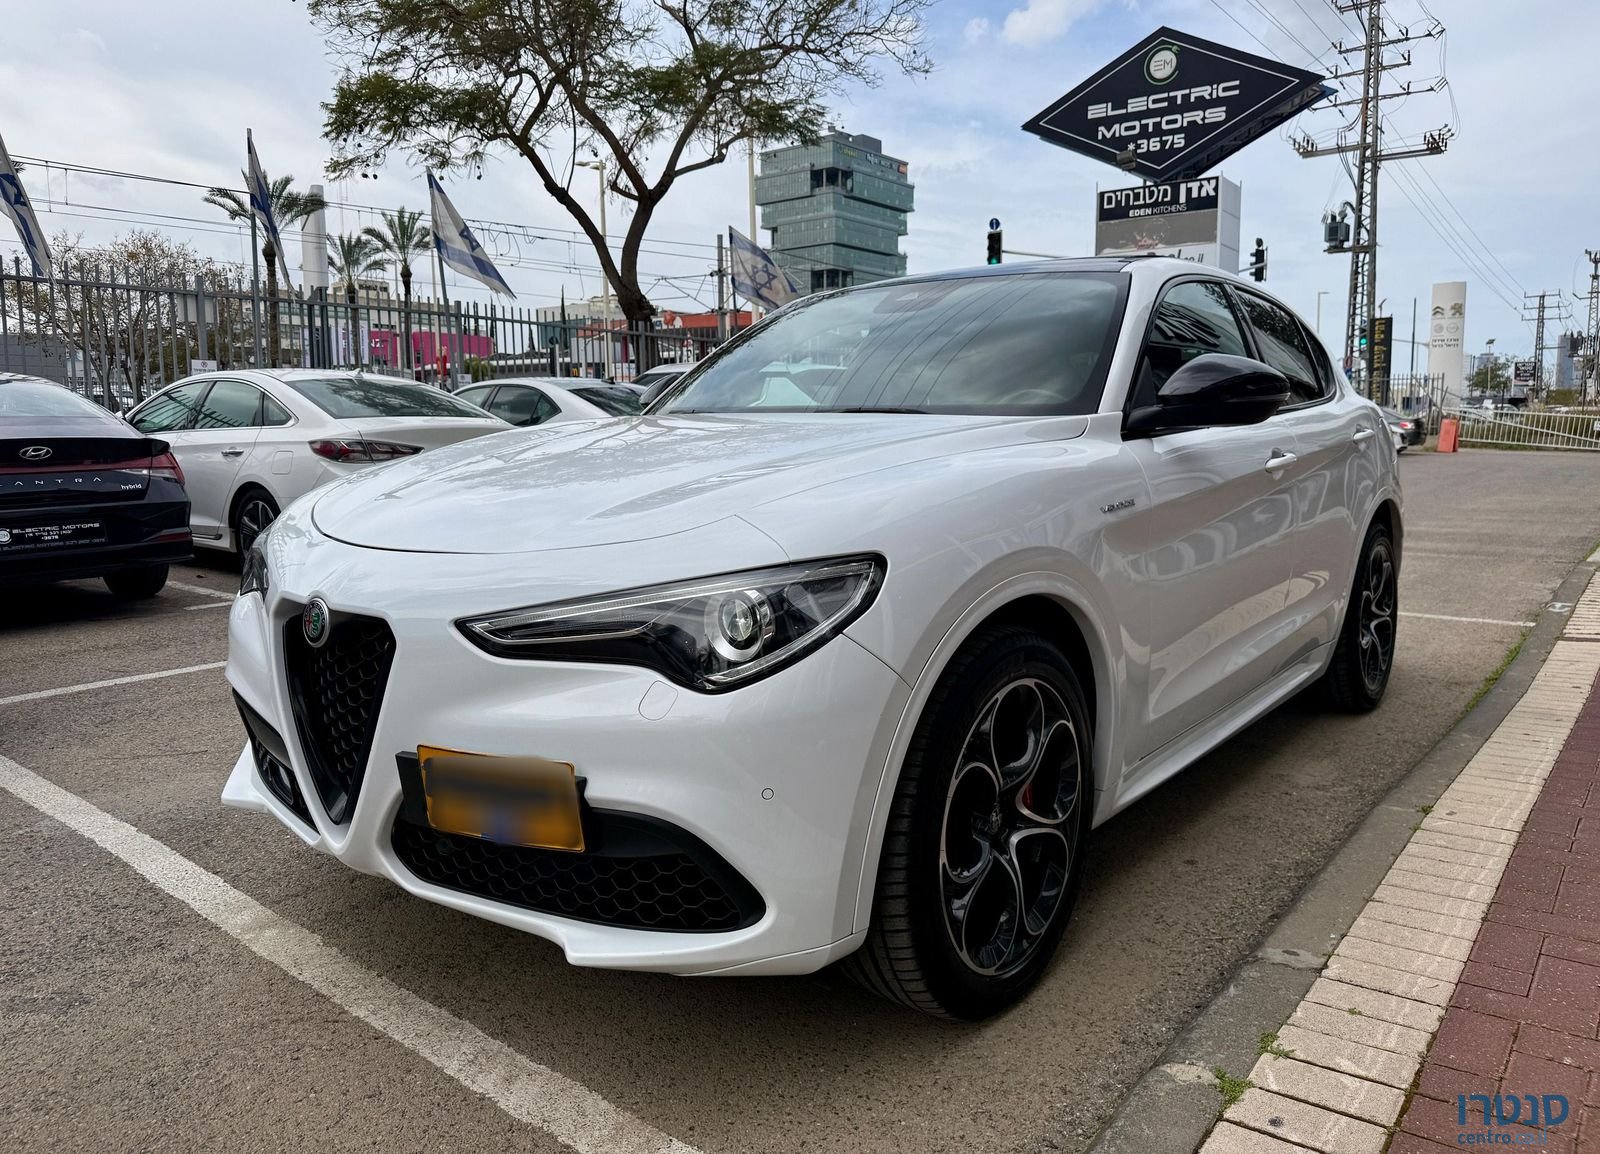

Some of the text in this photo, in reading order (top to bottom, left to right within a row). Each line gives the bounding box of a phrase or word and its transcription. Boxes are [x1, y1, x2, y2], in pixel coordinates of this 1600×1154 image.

[1097, 106, 1227, 140] MOTORS
[1103, 179, 1217, 210] אדן מטבחים
[1129, 203, 1188, 217] EDEN KITCHENS
[0, 476, 101, 486] ANTRA
[120, 483, 142, 491] hybrid
[62, 522, 100, 530] MOTORS
